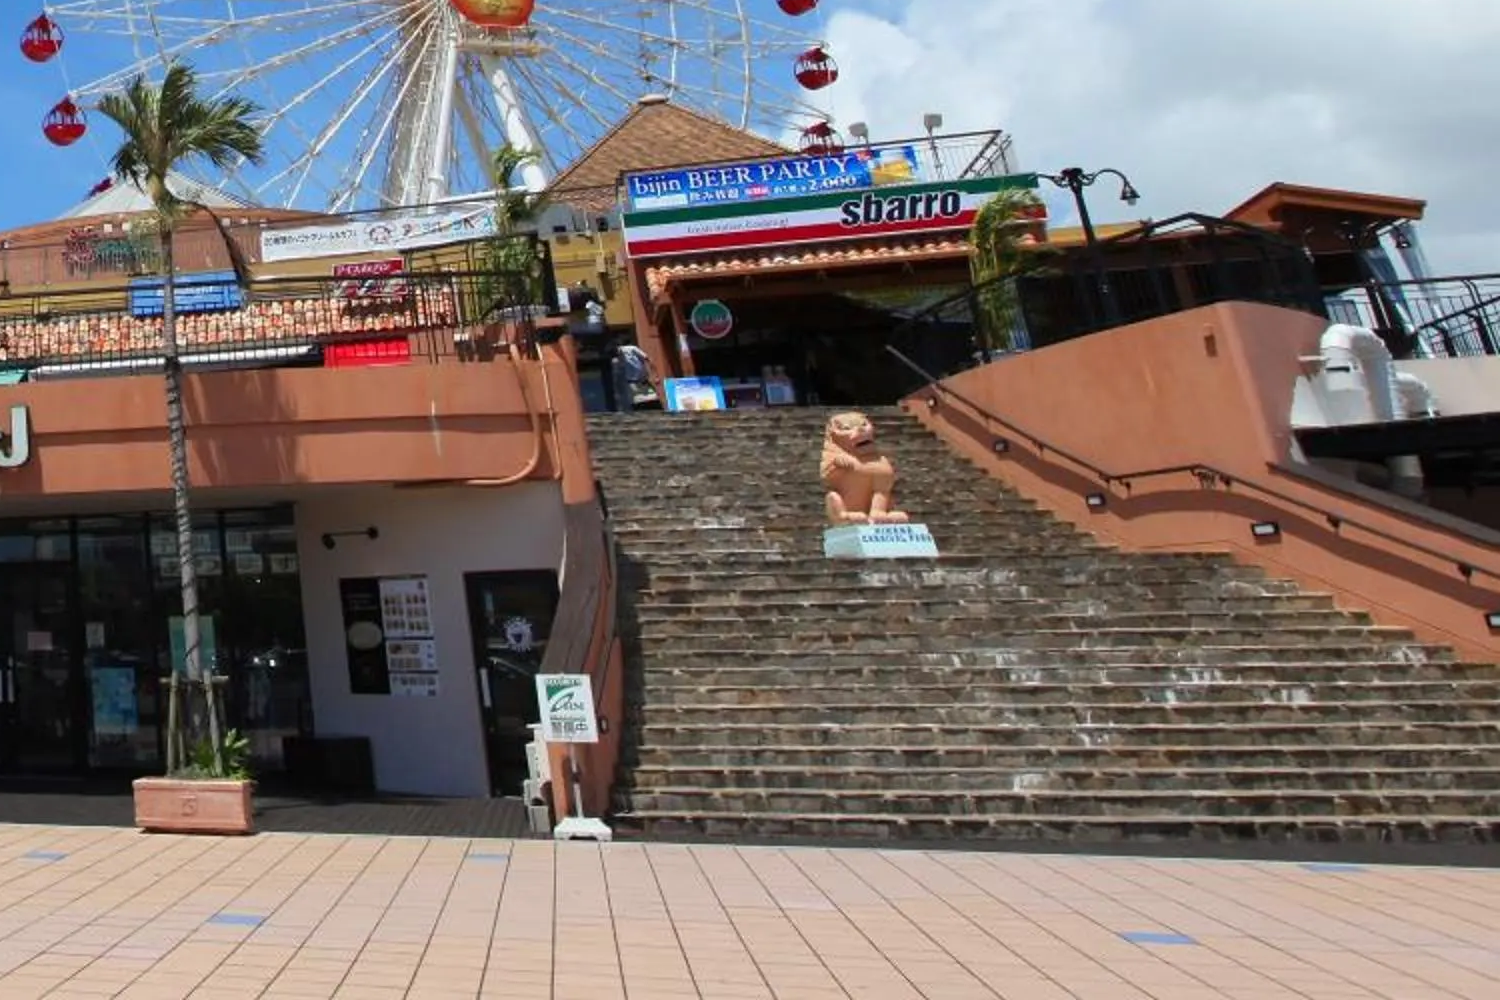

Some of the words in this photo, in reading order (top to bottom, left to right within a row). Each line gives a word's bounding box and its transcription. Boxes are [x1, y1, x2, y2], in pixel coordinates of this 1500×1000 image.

[633, 175, 681, 197] bijin
[687, 168, 753, 189] BEER
[759, 157, 849, 181] PARTY
[841, 189, 961, 227] sbarro
